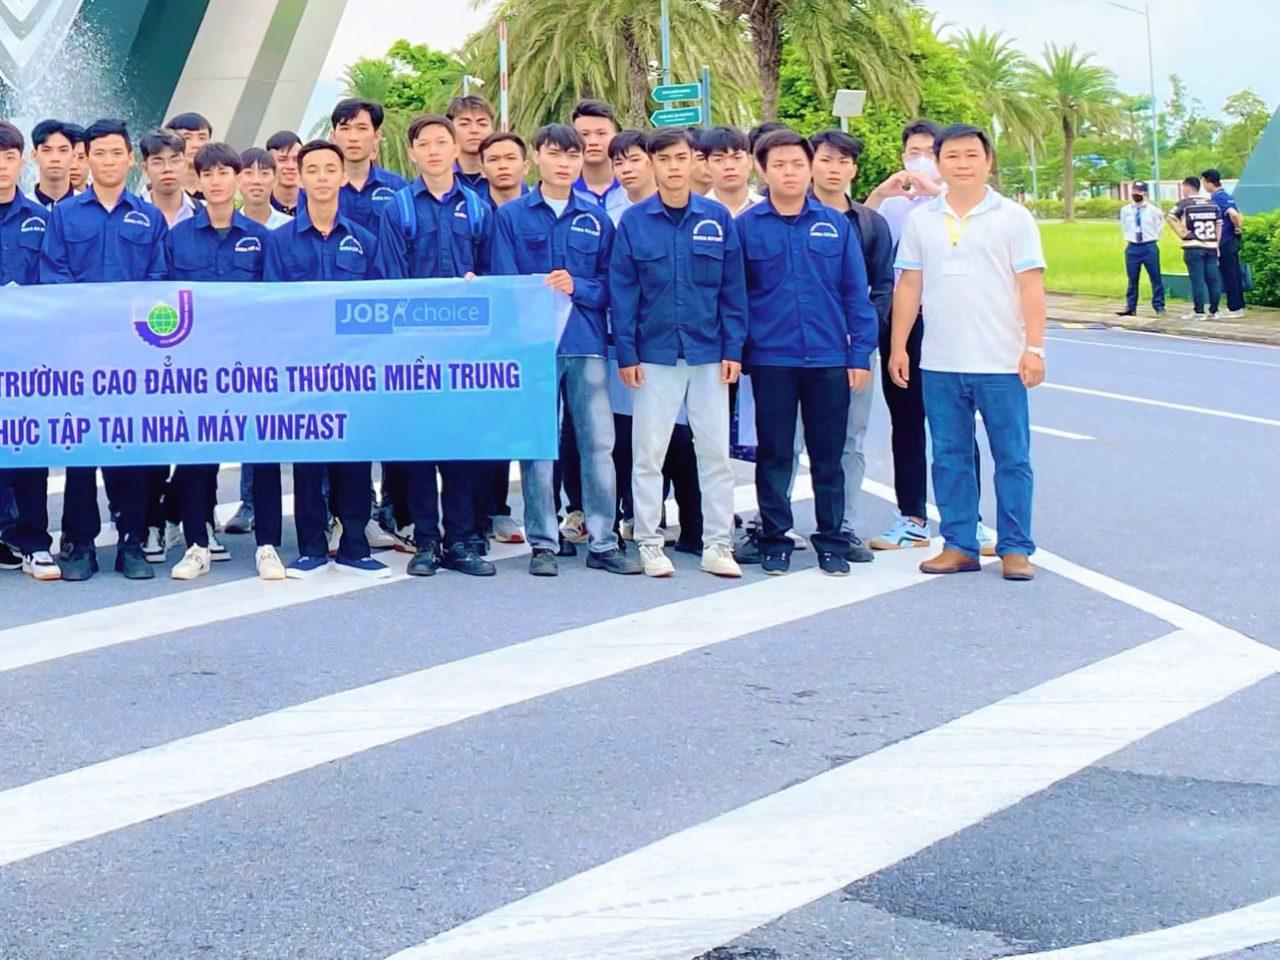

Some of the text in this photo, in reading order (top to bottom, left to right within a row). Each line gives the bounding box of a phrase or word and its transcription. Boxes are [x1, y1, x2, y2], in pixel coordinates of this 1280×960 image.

[1193, 221, 1216, 239] 22
[341, 302, 480, 323] JOB choice
[92, 369, 136, 395] CAO
[144, 356, 207, 394] ĐẲNG
[216, 361, 278, 393] CÔNG
[286, 363, 376, 392] THƯƠNG
[384, 355, 441, 390] MIỀN
[448, 362, 520, 389] TRUNG
[48, 412, 91, 450] TẬP
[99, 416, 133, 449] TẠI
[142, 410, 190, 443] NHÀ
[198, 409, 247, 443] MÁY
[255, 413, 347, 441] VINFAST
